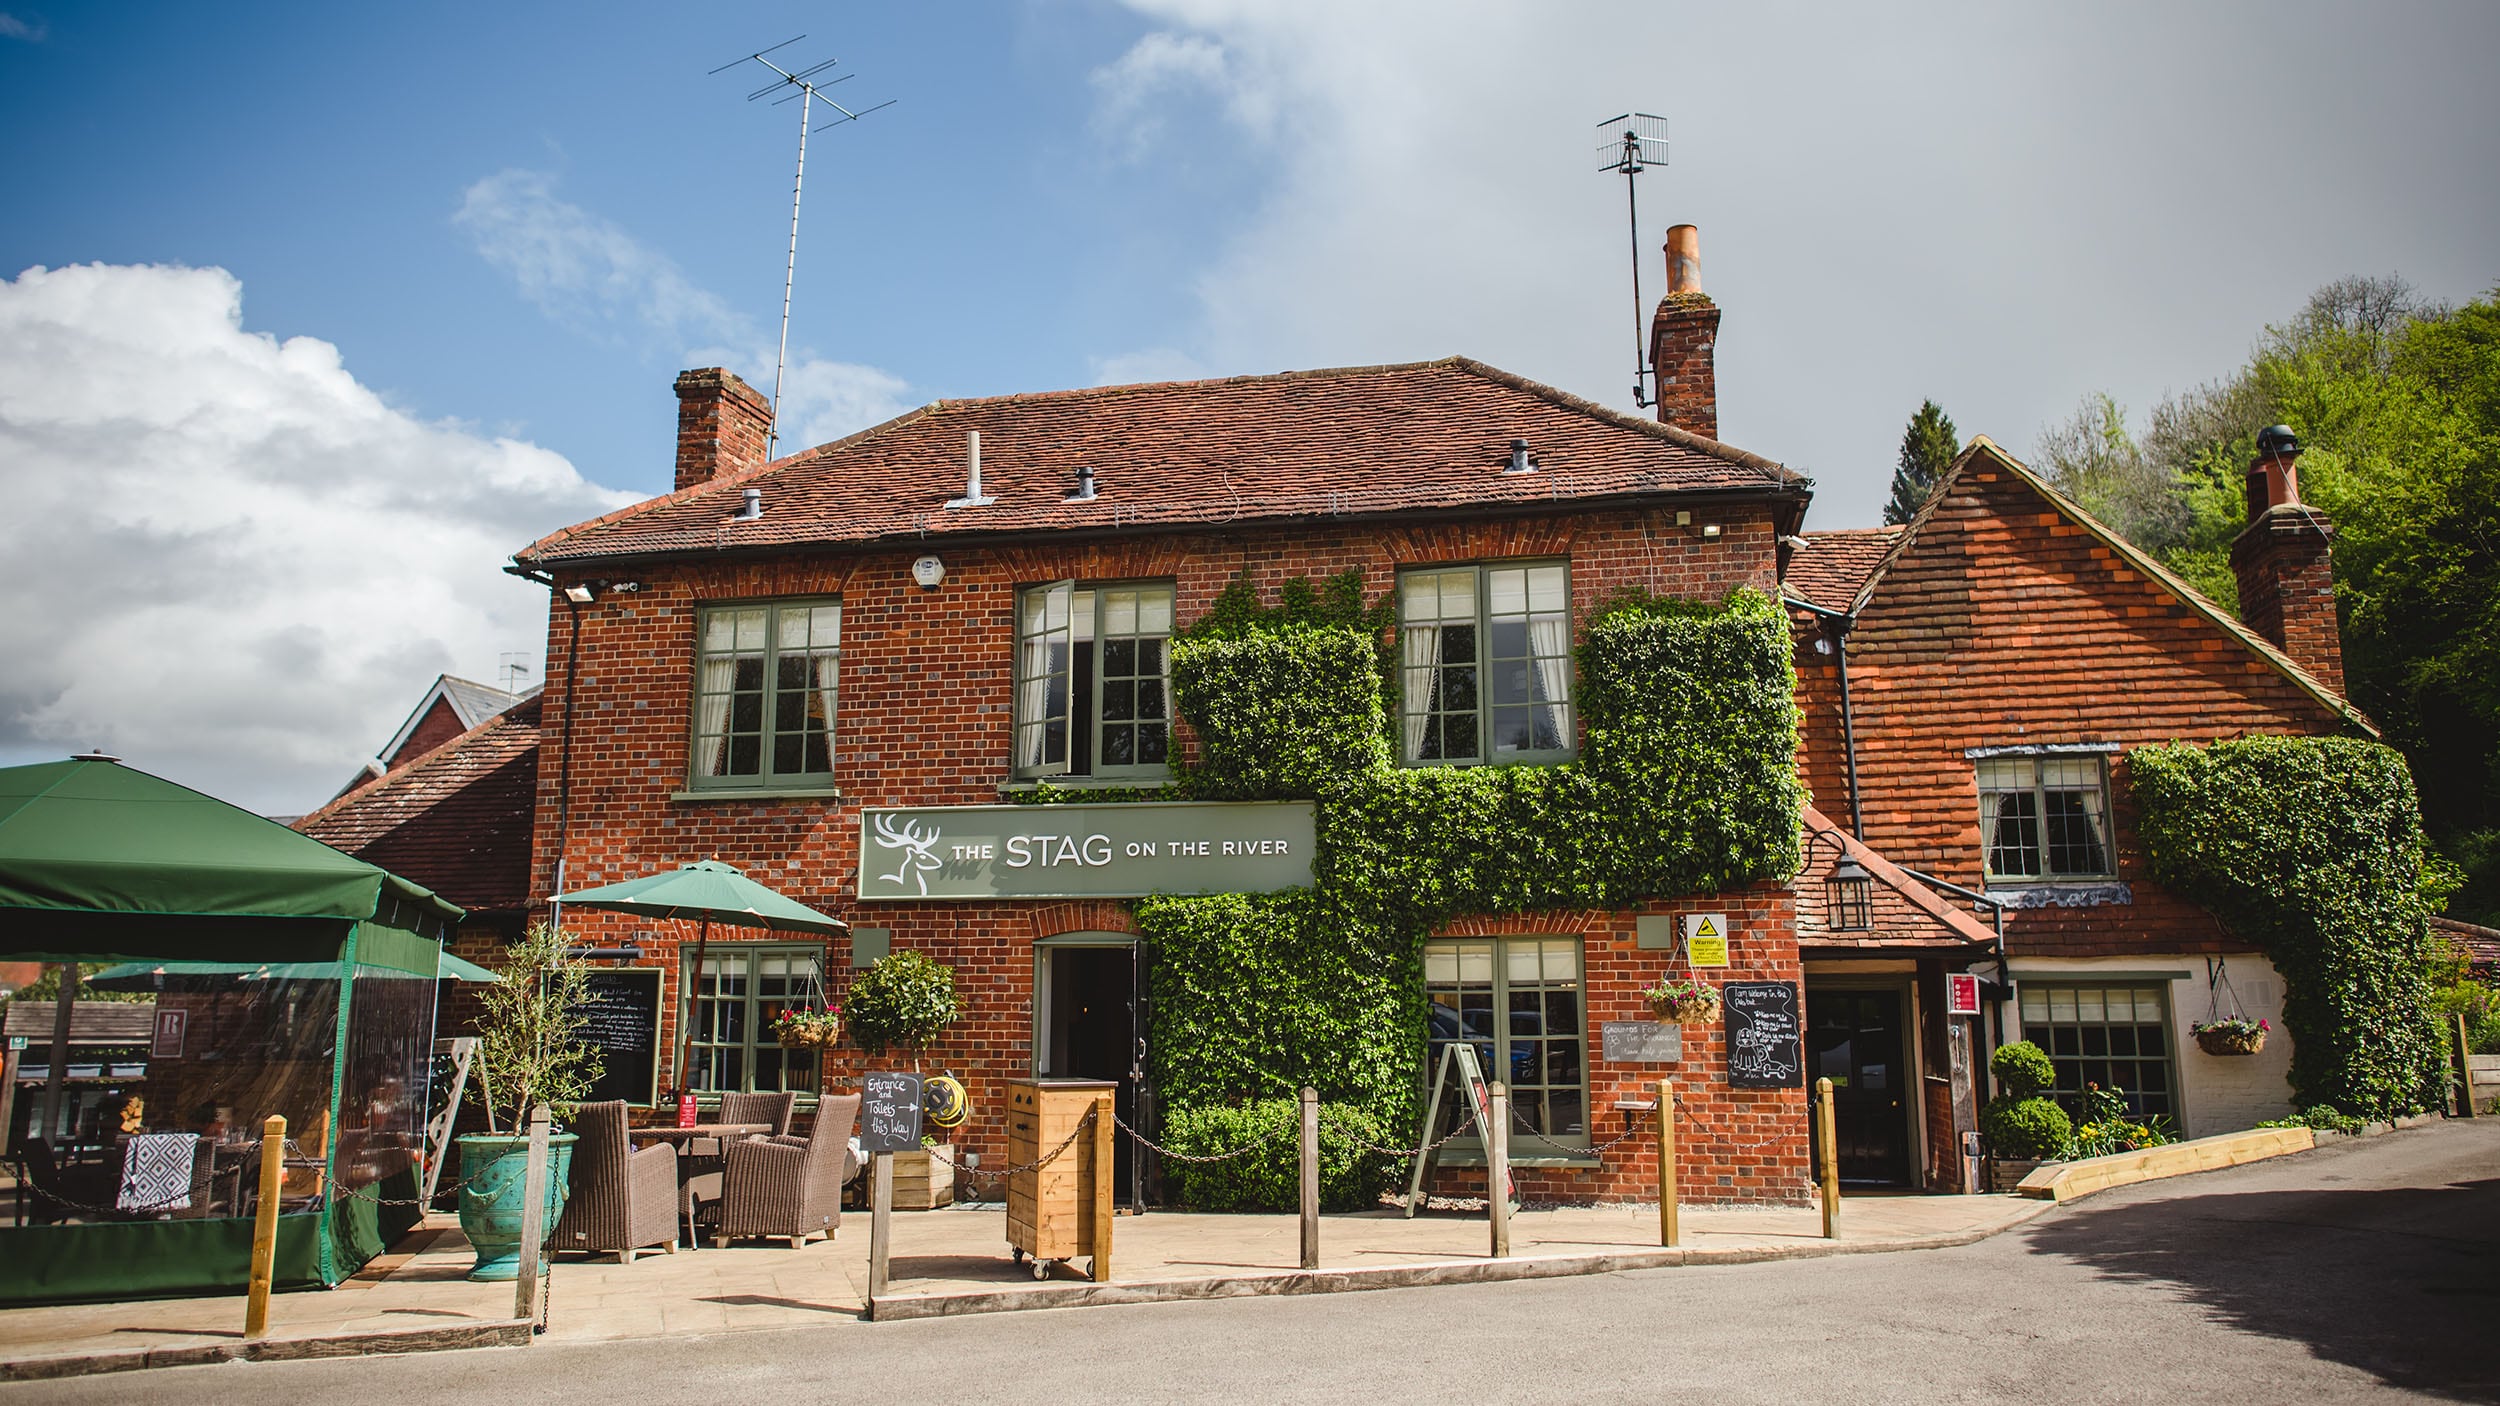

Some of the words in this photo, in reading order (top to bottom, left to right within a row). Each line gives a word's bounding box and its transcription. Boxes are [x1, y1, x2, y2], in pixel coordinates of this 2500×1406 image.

[952, 845, 993, 860] THE
[1006, 834, 1112, 867] STAG
[1126, 842, 1156, 856] ON
[1168, 841, 1210, 856] THE
[1222, 840, 1288, 855] RIVER
[1694, 939, 1721, 947] Warning
[868, 1078, 906, 1093] Entrance
[878, 1089, 893, 1098] and
[866, 1100, 896, 1117] Toilets
[870, 1117, 888, 1136] this
[890, 1118, 910, 1142] Way
